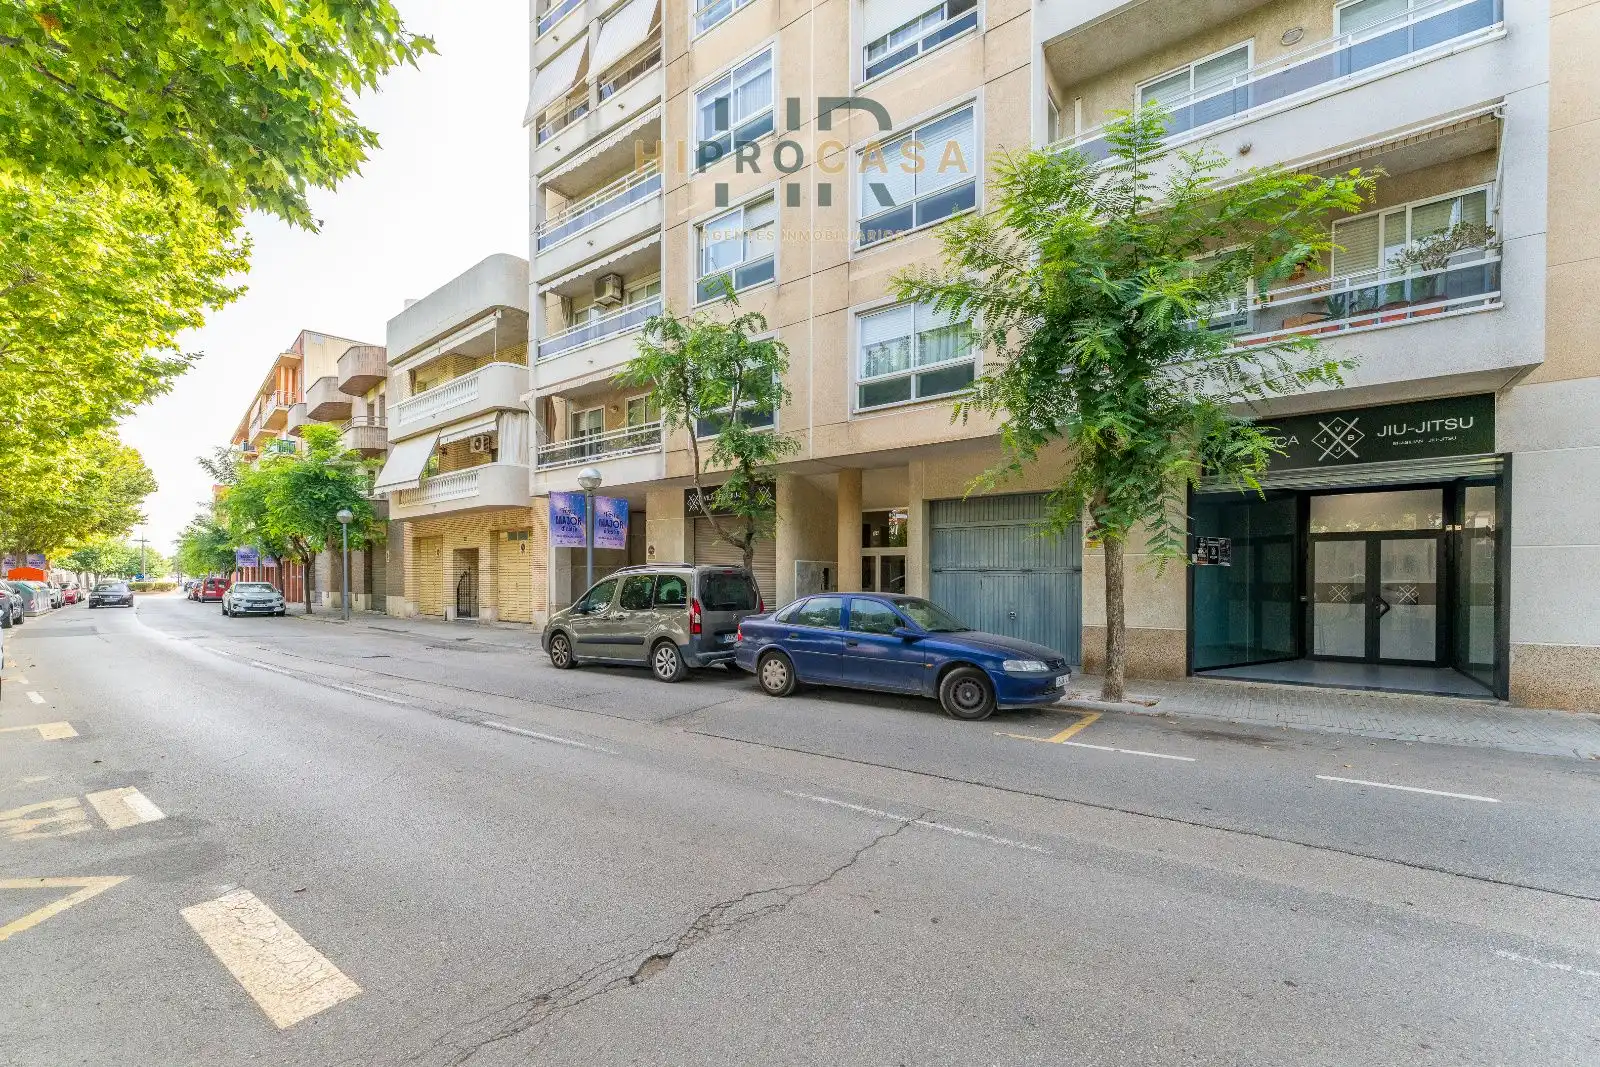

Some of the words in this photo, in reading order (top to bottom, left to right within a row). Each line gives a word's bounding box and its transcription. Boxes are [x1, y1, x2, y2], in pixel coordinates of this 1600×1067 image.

[1377, 416, 1474, 437] JIU-JITSU
[555, 515, 582, 526] MAJOR
[598, 518, 624, 529] MAJOR
